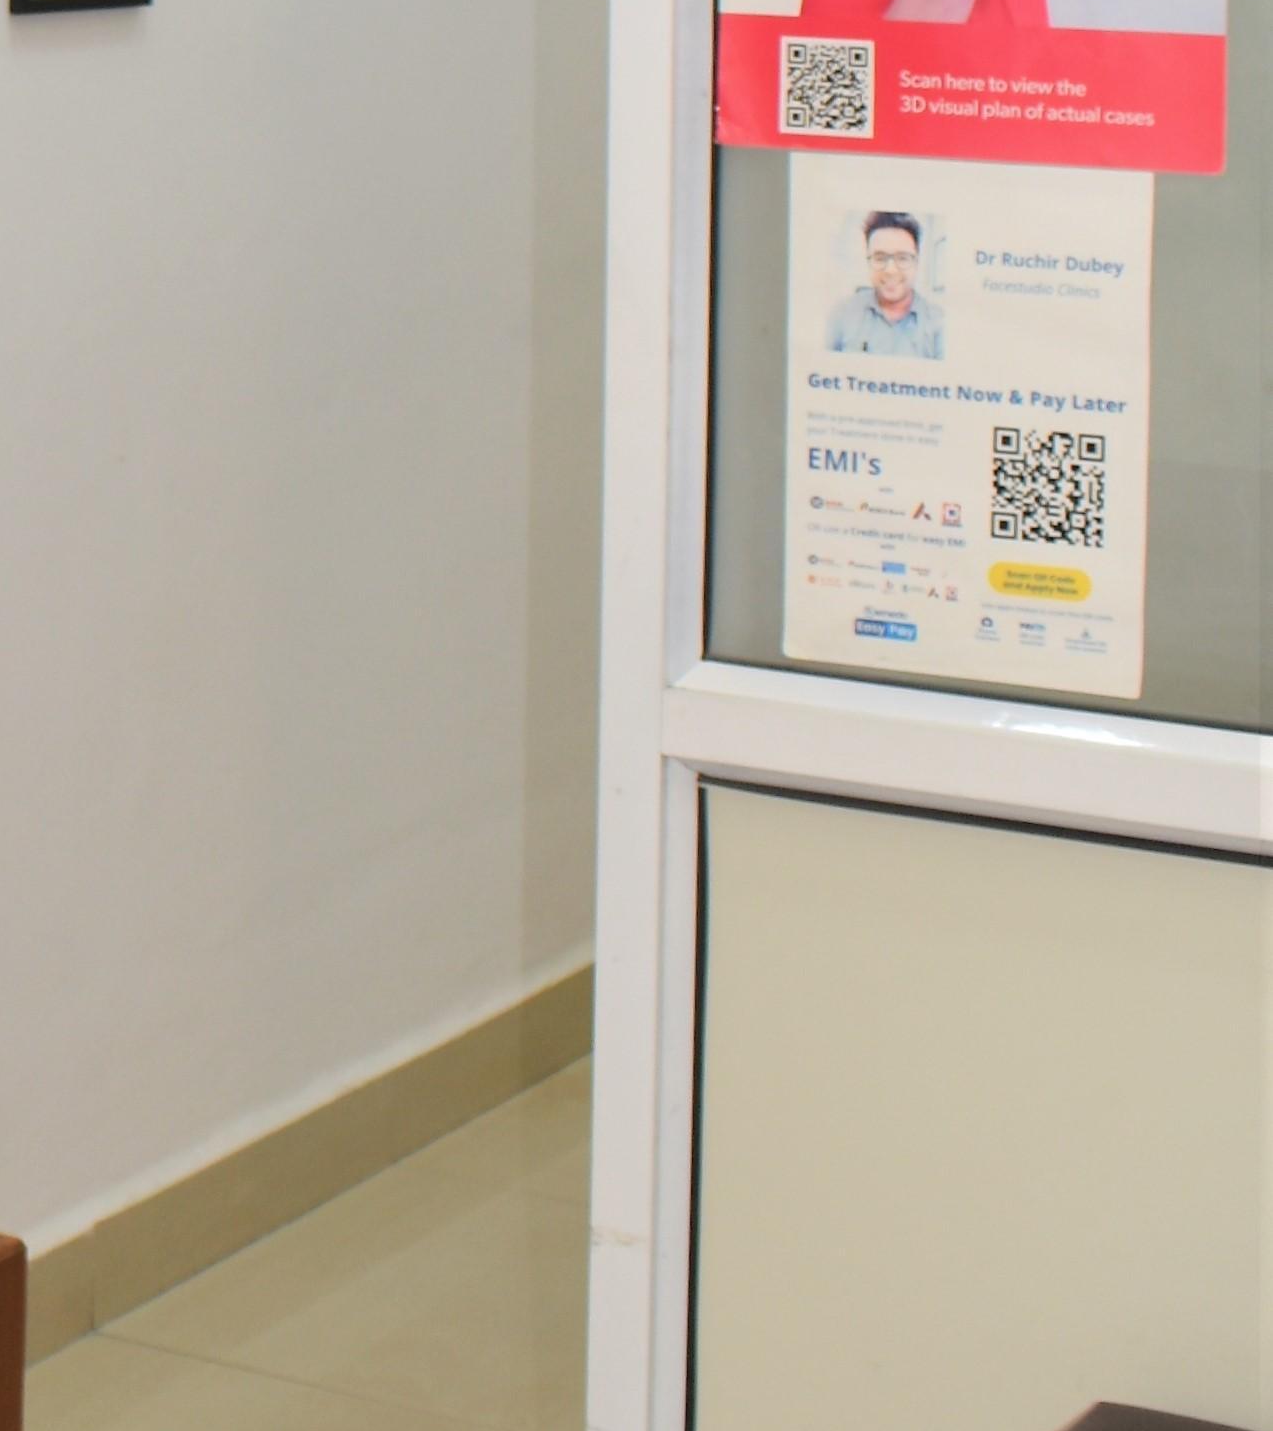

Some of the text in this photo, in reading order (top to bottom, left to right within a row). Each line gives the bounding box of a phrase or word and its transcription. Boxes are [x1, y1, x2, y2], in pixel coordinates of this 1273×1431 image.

[900, 70, 1086, 97] Scan here to view the
[900, 95, 1155, 127] 3D visual plan of actual cases
[976, 250, 1124, 278] Dr Ruchir Dubey
[808, 373, 1126, 413] Get Treatment Now & Pay Later
[809, 448, 881, 475] EMI's
